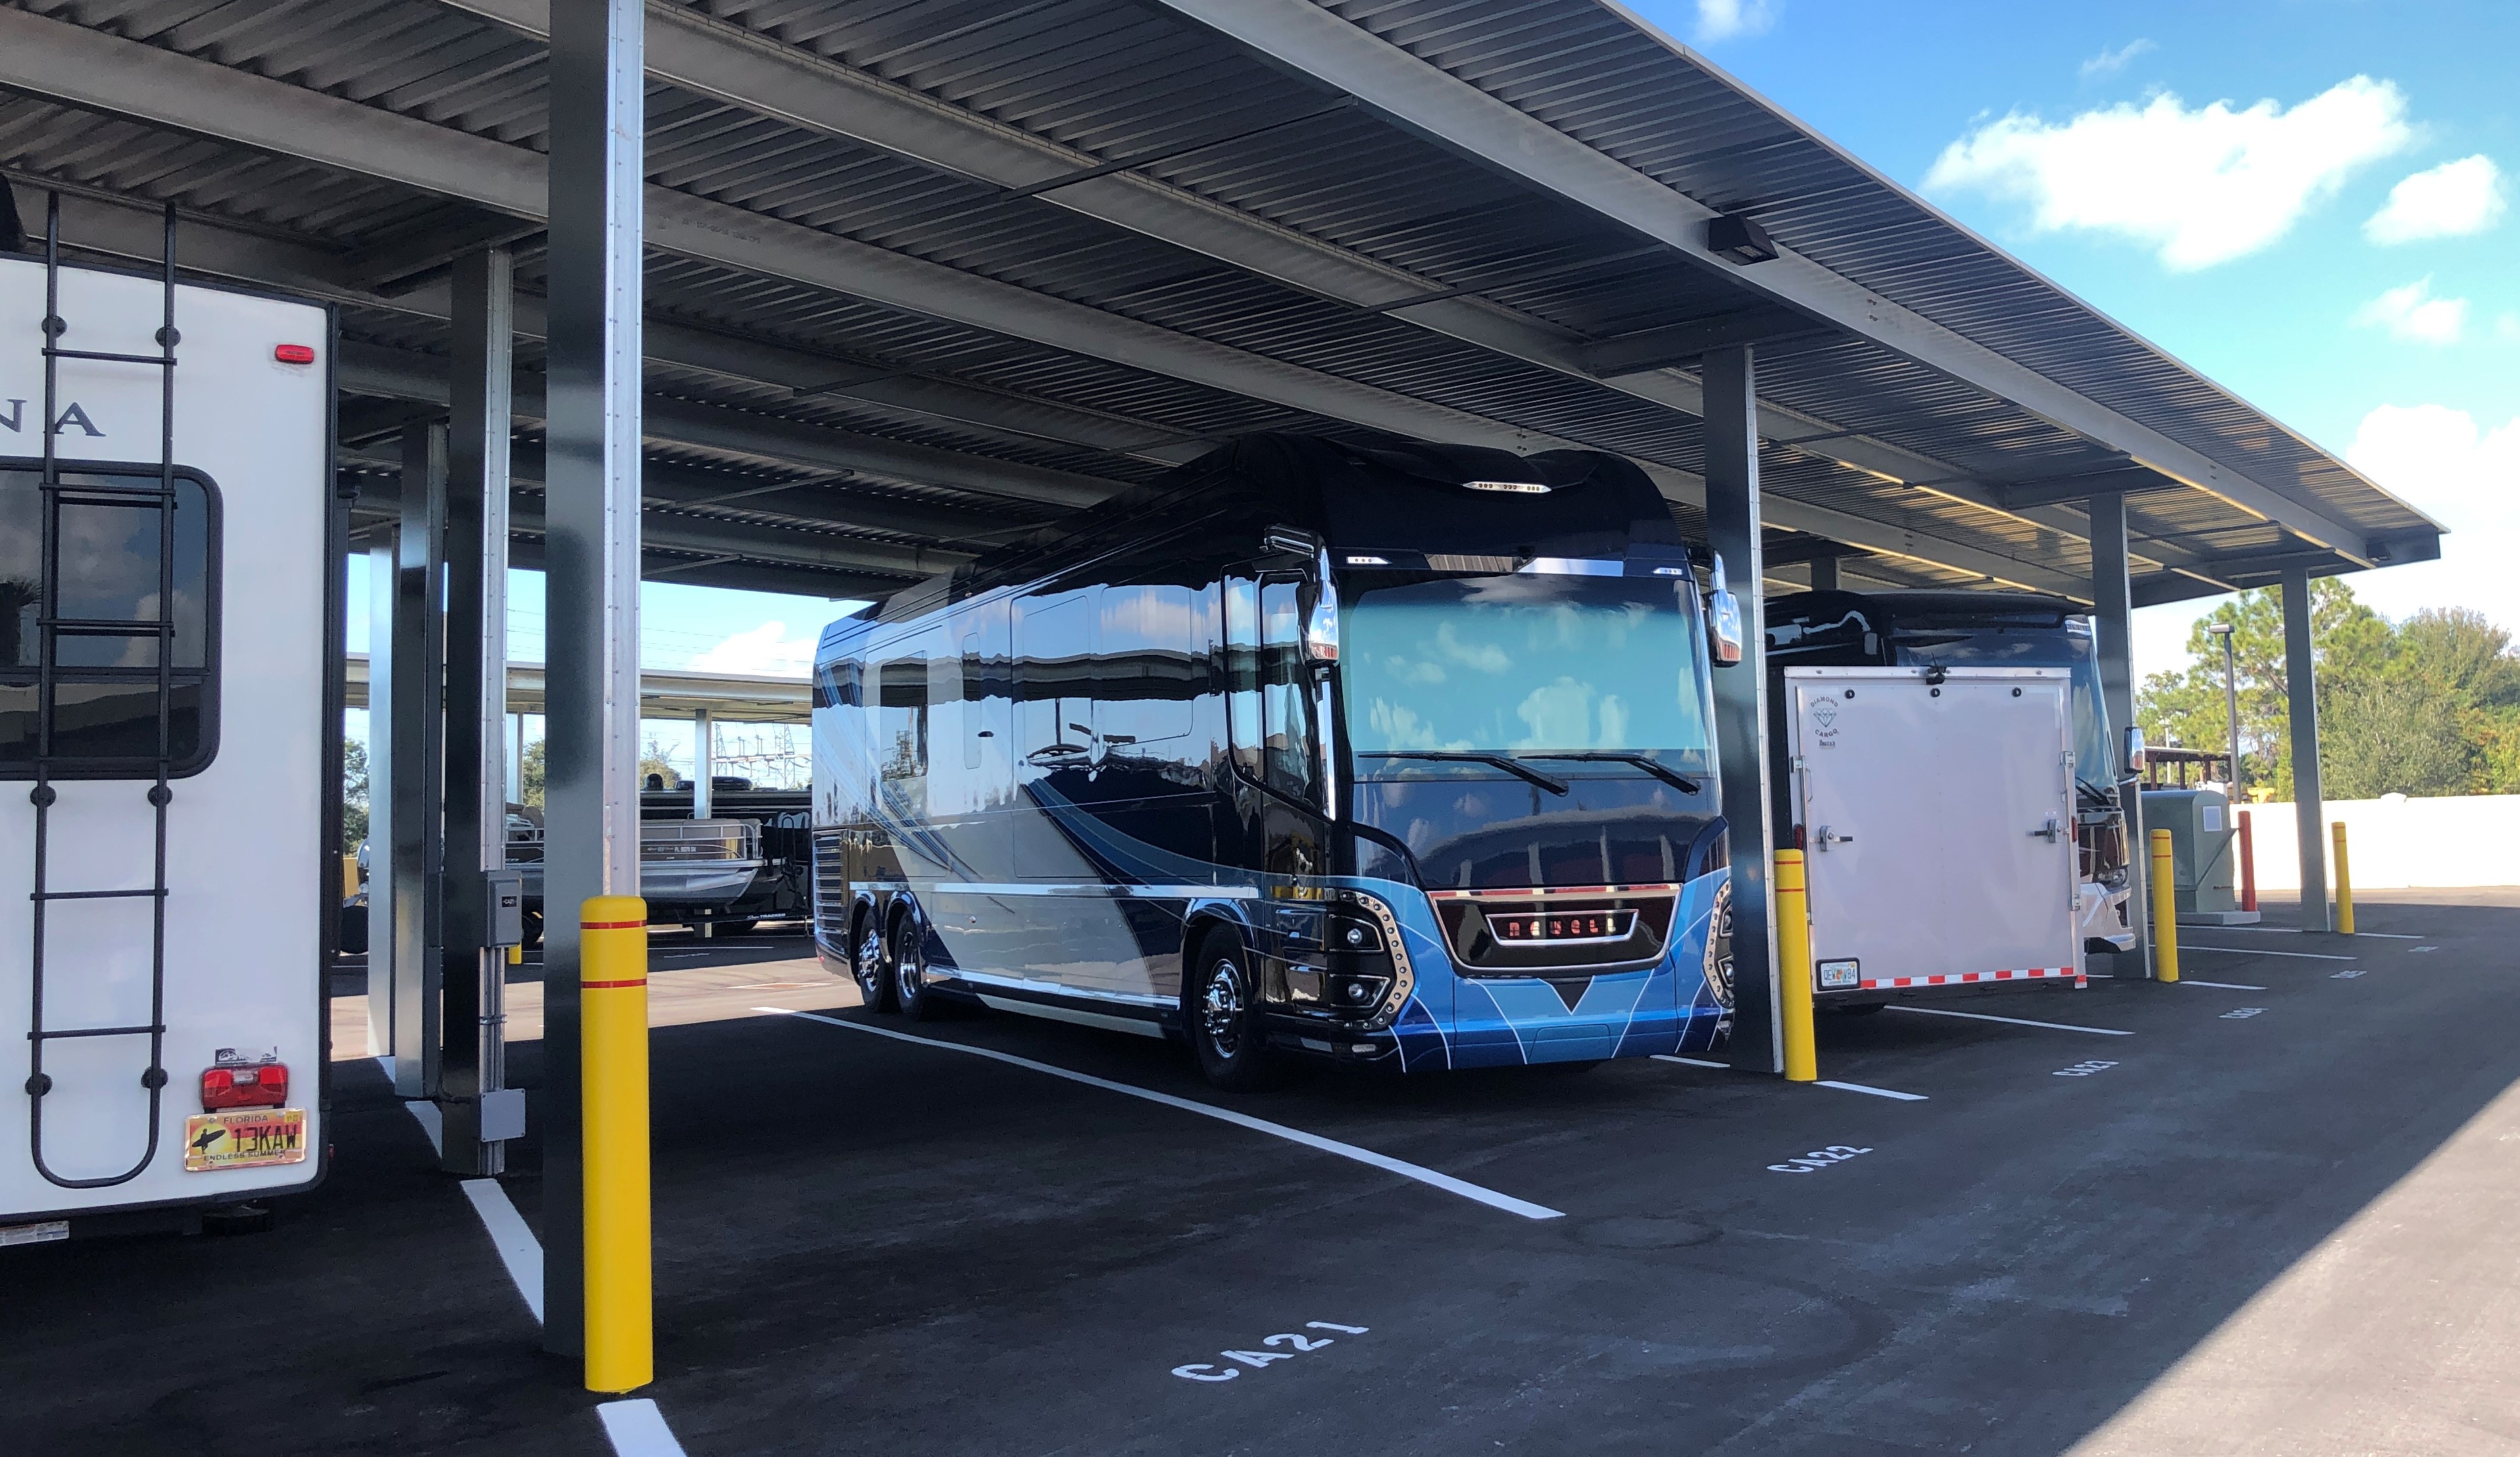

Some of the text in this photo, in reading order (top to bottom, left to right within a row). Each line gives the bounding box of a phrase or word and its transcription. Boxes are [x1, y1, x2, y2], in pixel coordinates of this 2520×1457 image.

[1811, 696, 1838, 708] DIAMOND
[1815, 728, 1838, 737] CARGO
[2052, 1060, 2119, 1076] CA23
[224, 1115, 268, 1124] FLORIDA
[234, 1124, 297, 1152] 13KAW
[204, 1150, 286, 1161] ENDLESS SUMMER
[1766, 1145, 1874, 1172] CA22
[1171, 1321, 1369, 1381] CA21
